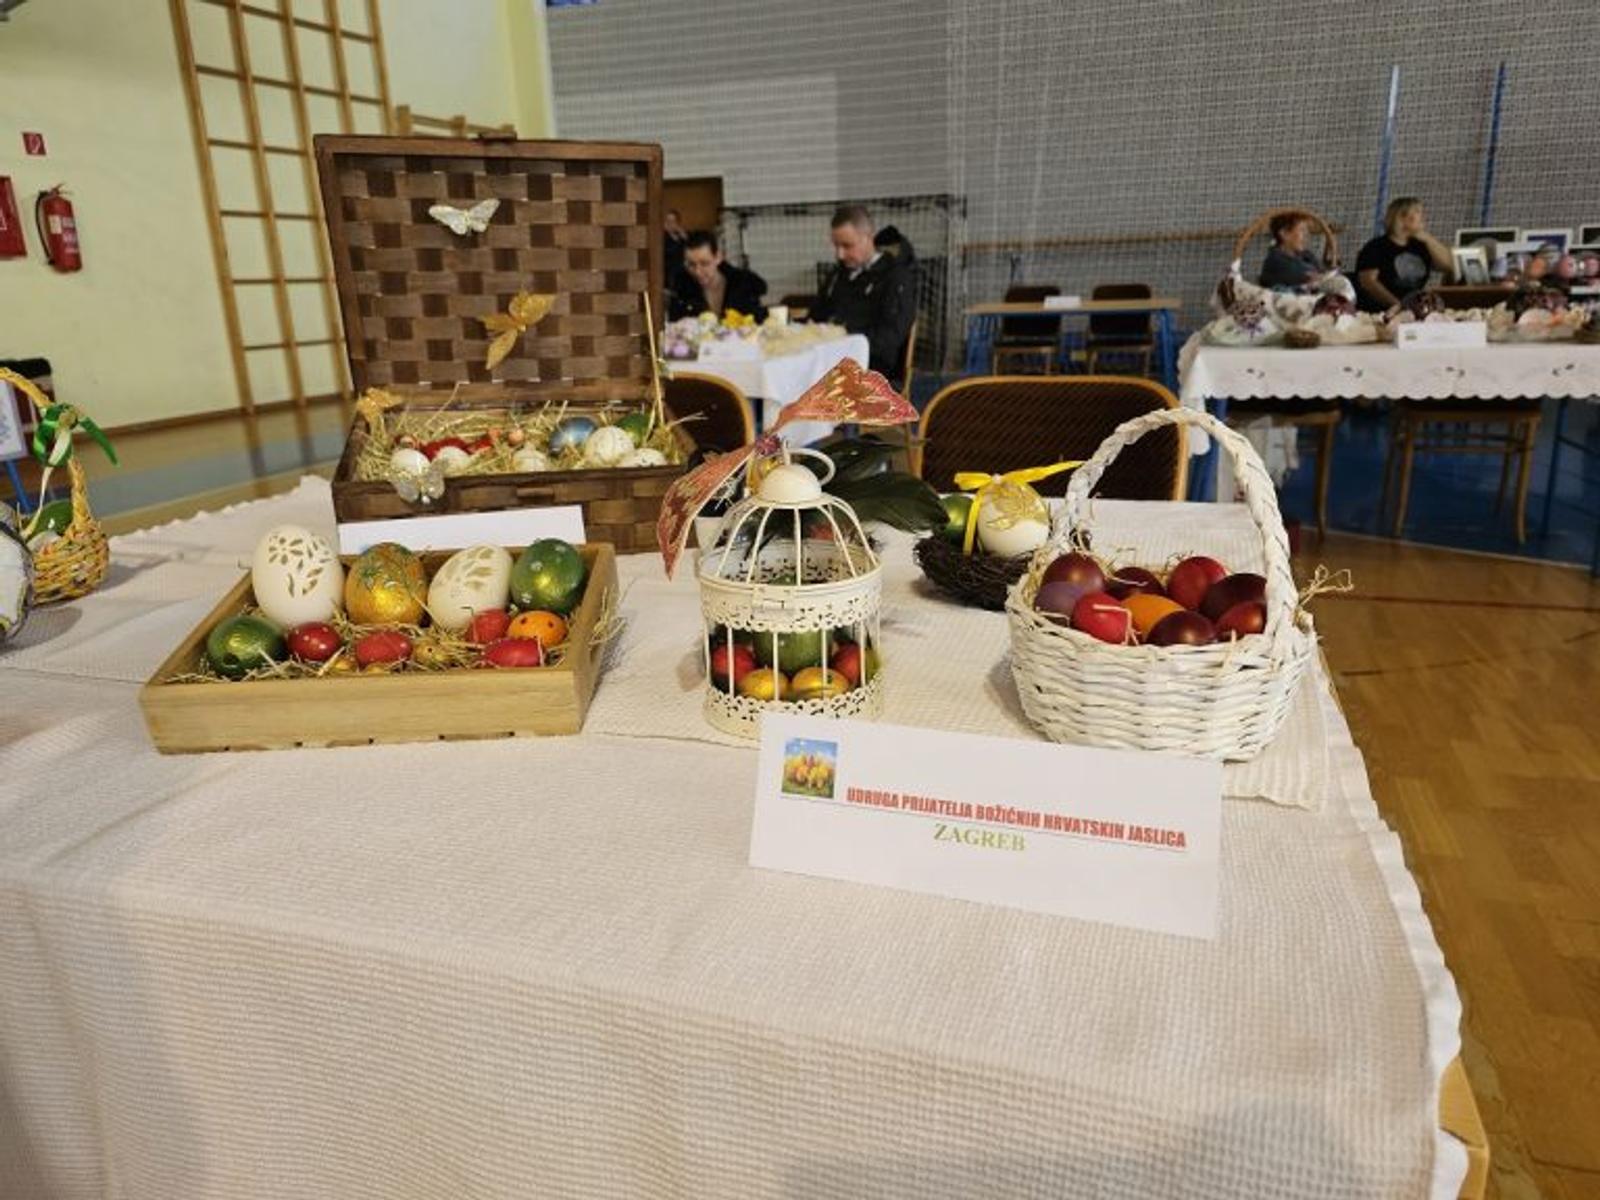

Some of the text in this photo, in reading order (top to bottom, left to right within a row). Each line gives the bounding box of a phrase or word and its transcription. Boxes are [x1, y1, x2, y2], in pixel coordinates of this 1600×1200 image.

[846, 787, 899, 808] UDRUGA
[902, 794, 973, 818] PRIJATELJA
[1128, 825, 1186, 847] JASLICA
[933, 823, 1025, 851] ZAGREB
